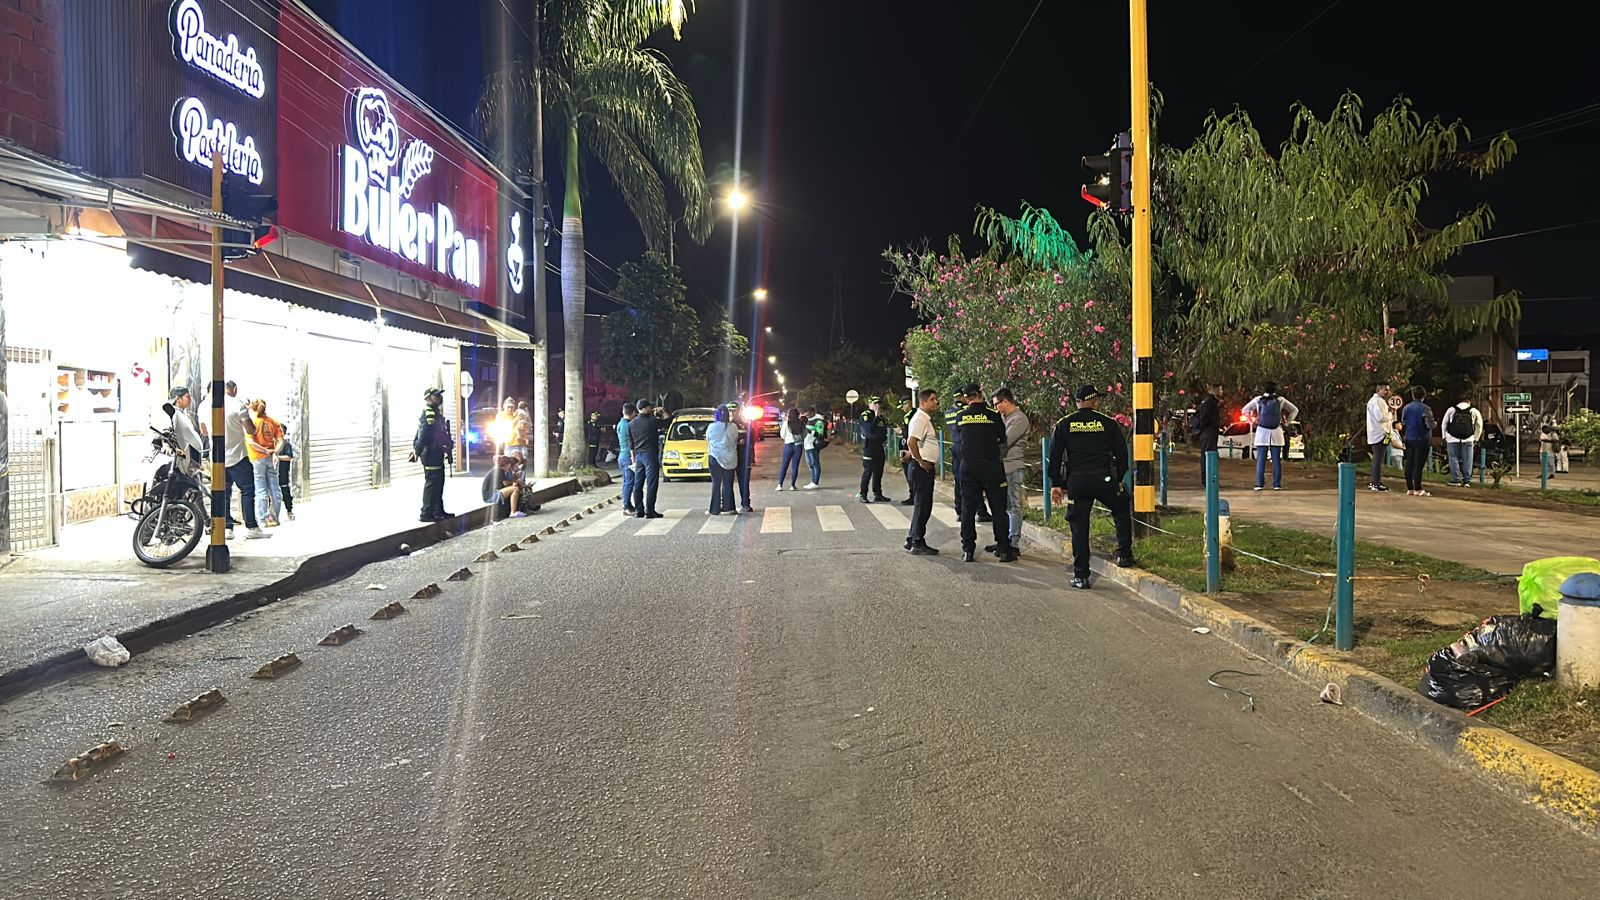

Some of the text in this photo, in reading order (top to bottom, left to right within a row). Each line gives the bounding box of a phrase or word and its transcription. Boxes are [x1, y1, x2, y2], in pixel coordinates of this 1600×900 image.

[436, 203, 480, 288] Pan
[1390, 397, 1402, 406] 30
[962, 413, 988, 421] POLICÍA
[1070, 420, 1103, 428] POLICÍA
